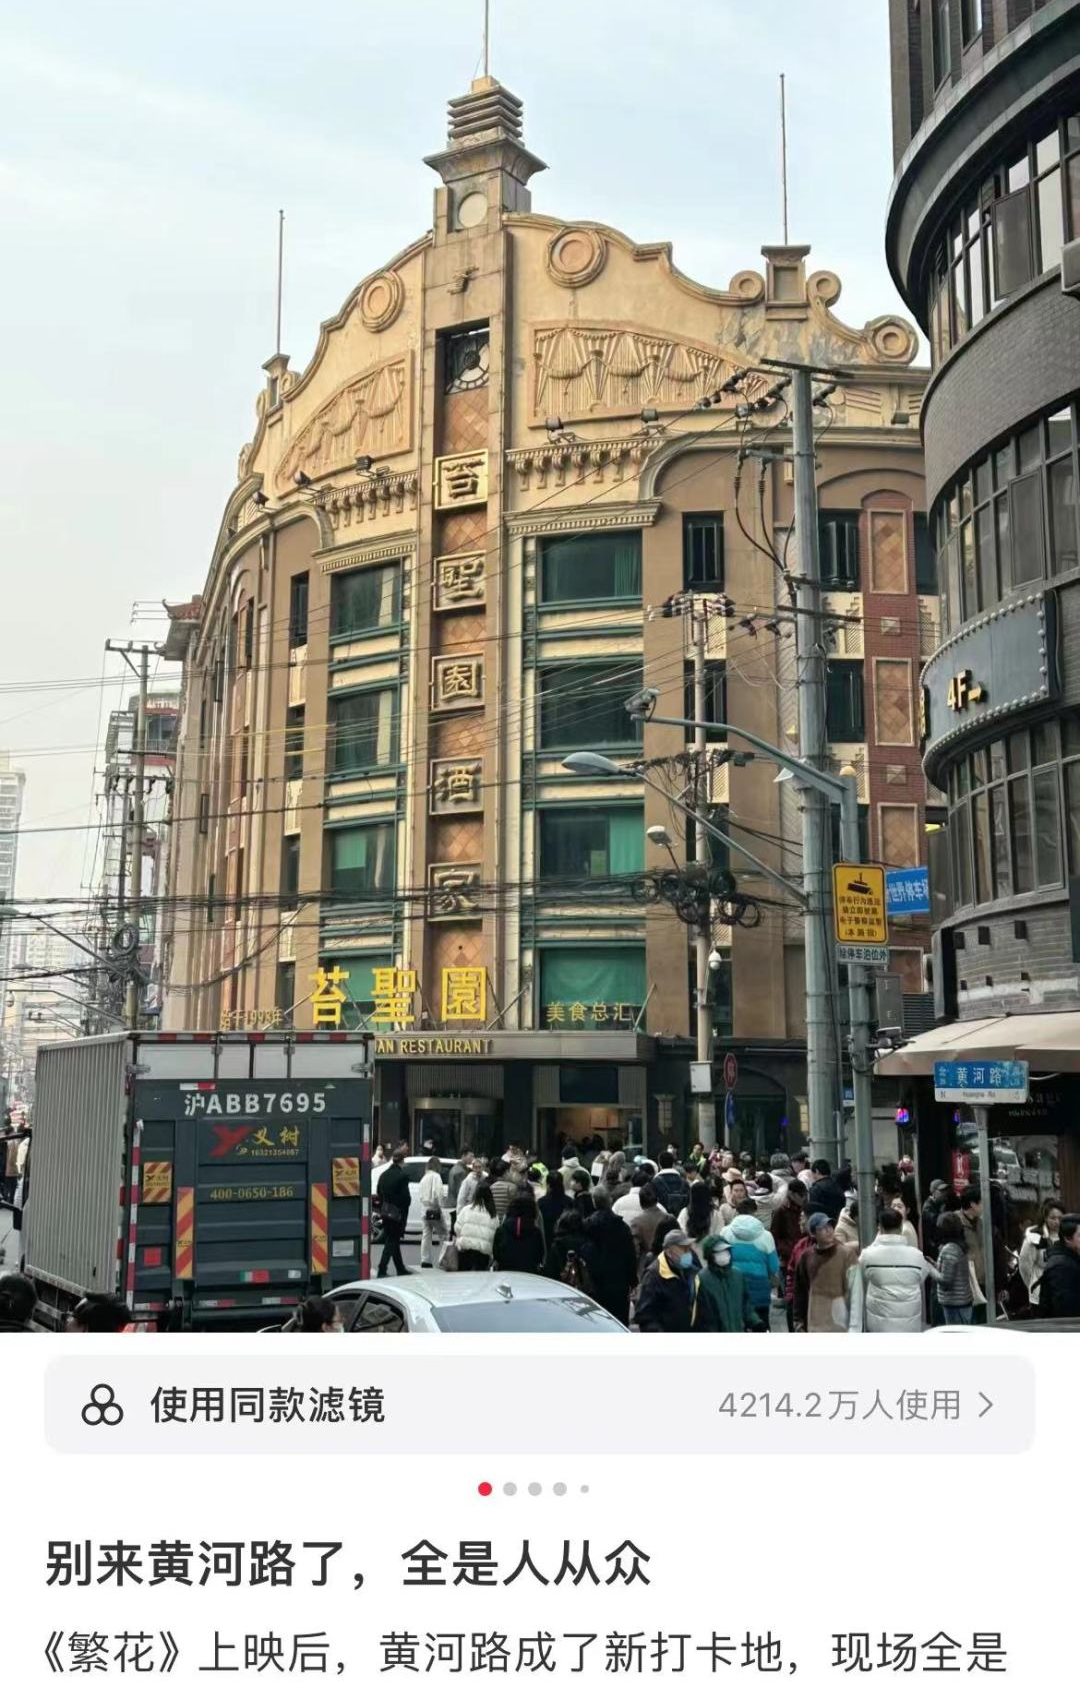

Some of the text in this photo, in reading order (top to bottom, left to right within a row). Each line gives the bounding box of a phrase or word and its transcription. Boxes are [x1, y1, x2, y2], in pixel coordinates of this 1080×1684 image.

[546, 1001, 633, 1022] 美食总汇
[400, 1039, 490, 1054] RESTAURANT
[956, 1067, 1002, 1085] 黄河路
[184, 1092, 326, 1116] 沪ABB7695
[210, 1186, 294, 1200] 400-0650-186
